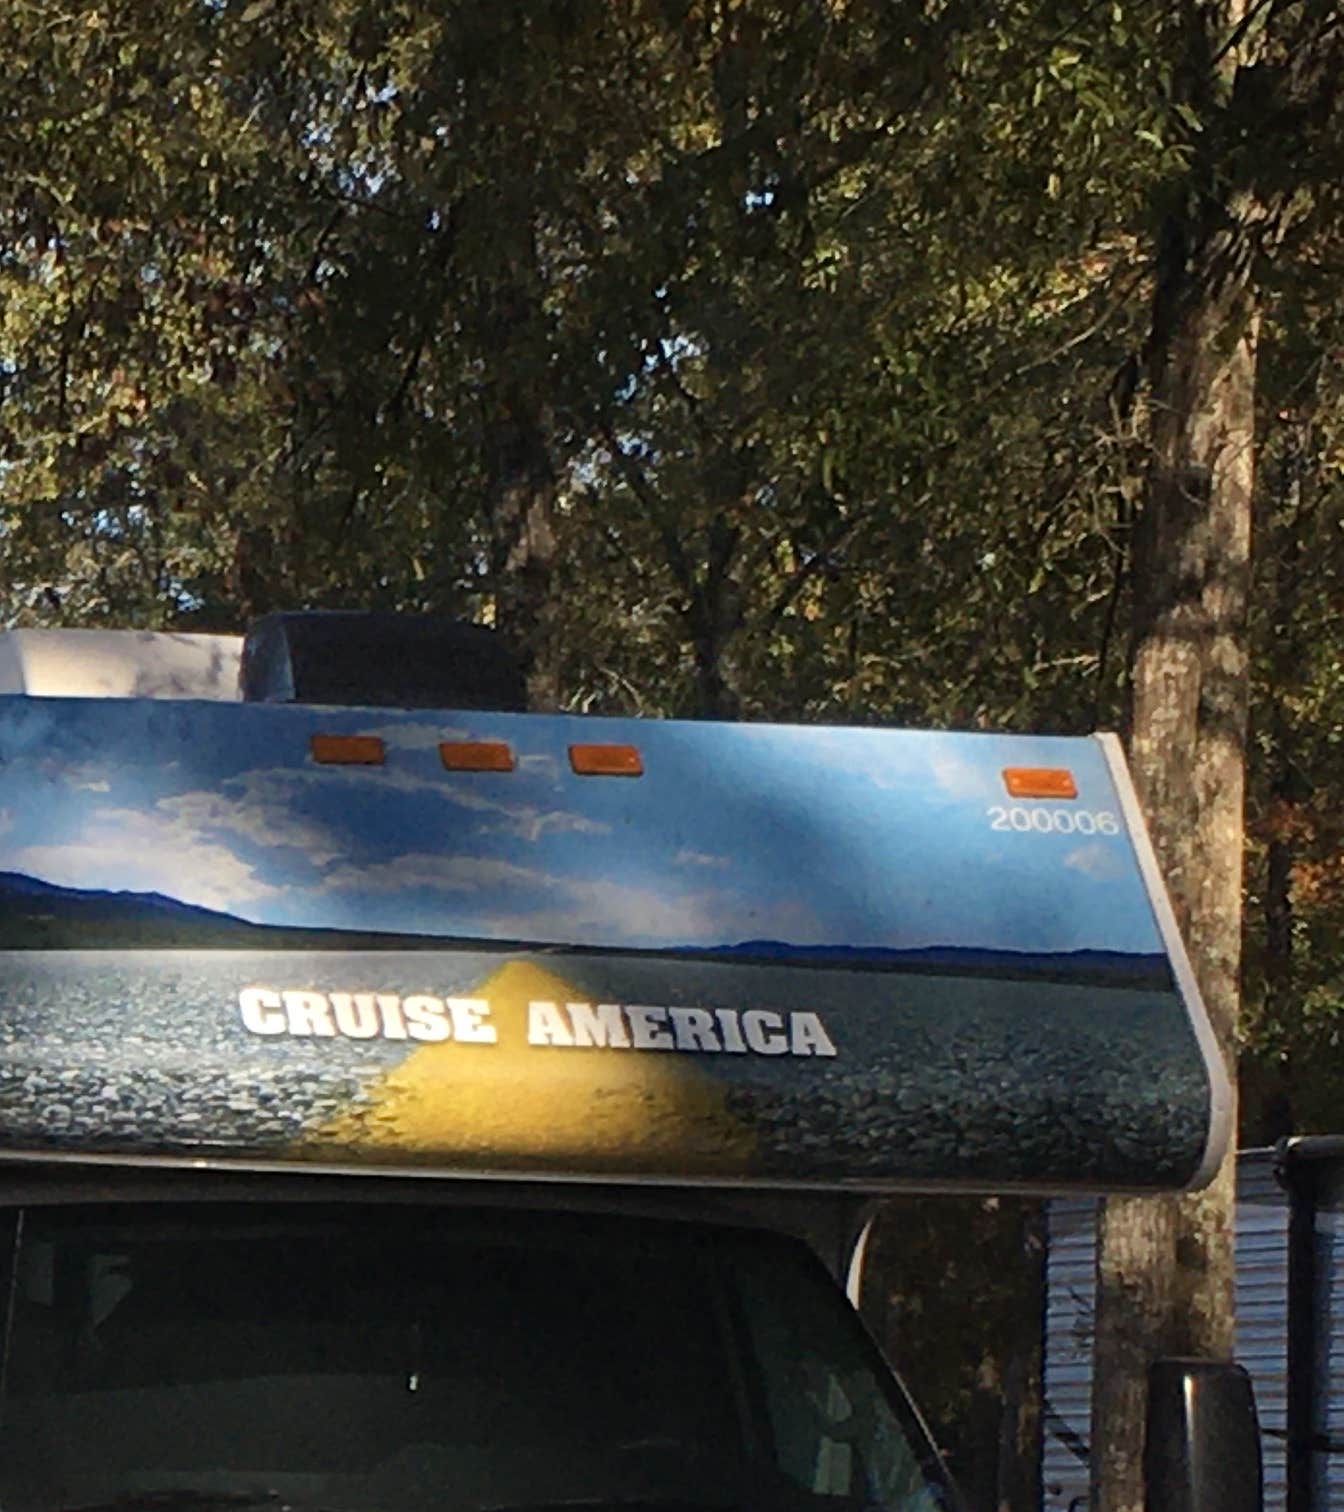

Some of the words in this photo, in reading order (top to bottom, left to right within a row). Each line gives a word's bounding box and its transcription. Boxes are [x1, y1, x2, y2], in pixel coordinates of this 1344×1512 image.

[986, 805, 1120, 836] 200006
[237, 986, 498, 1045] CRUISE
[526, 1000, 838, 1058] AMERICA
